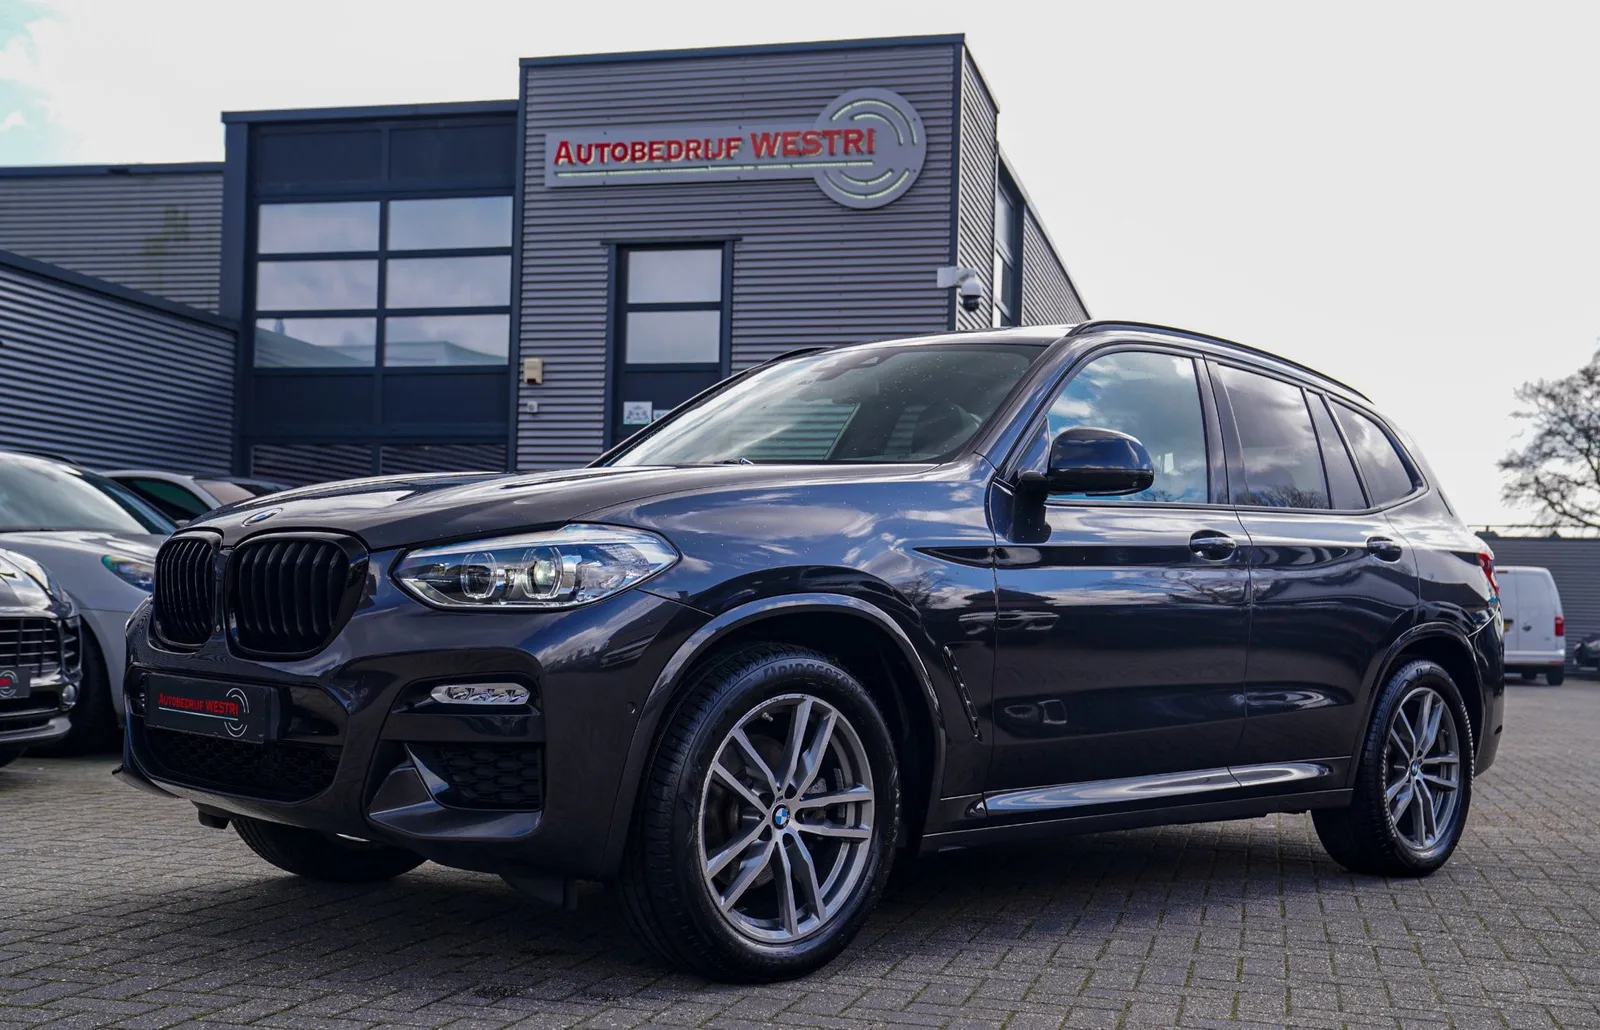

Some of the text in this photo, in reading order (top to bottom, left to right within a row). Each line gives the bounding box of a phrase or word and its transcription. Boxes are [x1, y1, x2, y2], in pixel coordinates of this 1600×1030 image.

[553, 127, 876, 166] AUTOBEDRIJF WESTRI
[159, 693, 239, 716] AUTOBEDRIJF WESTRI
